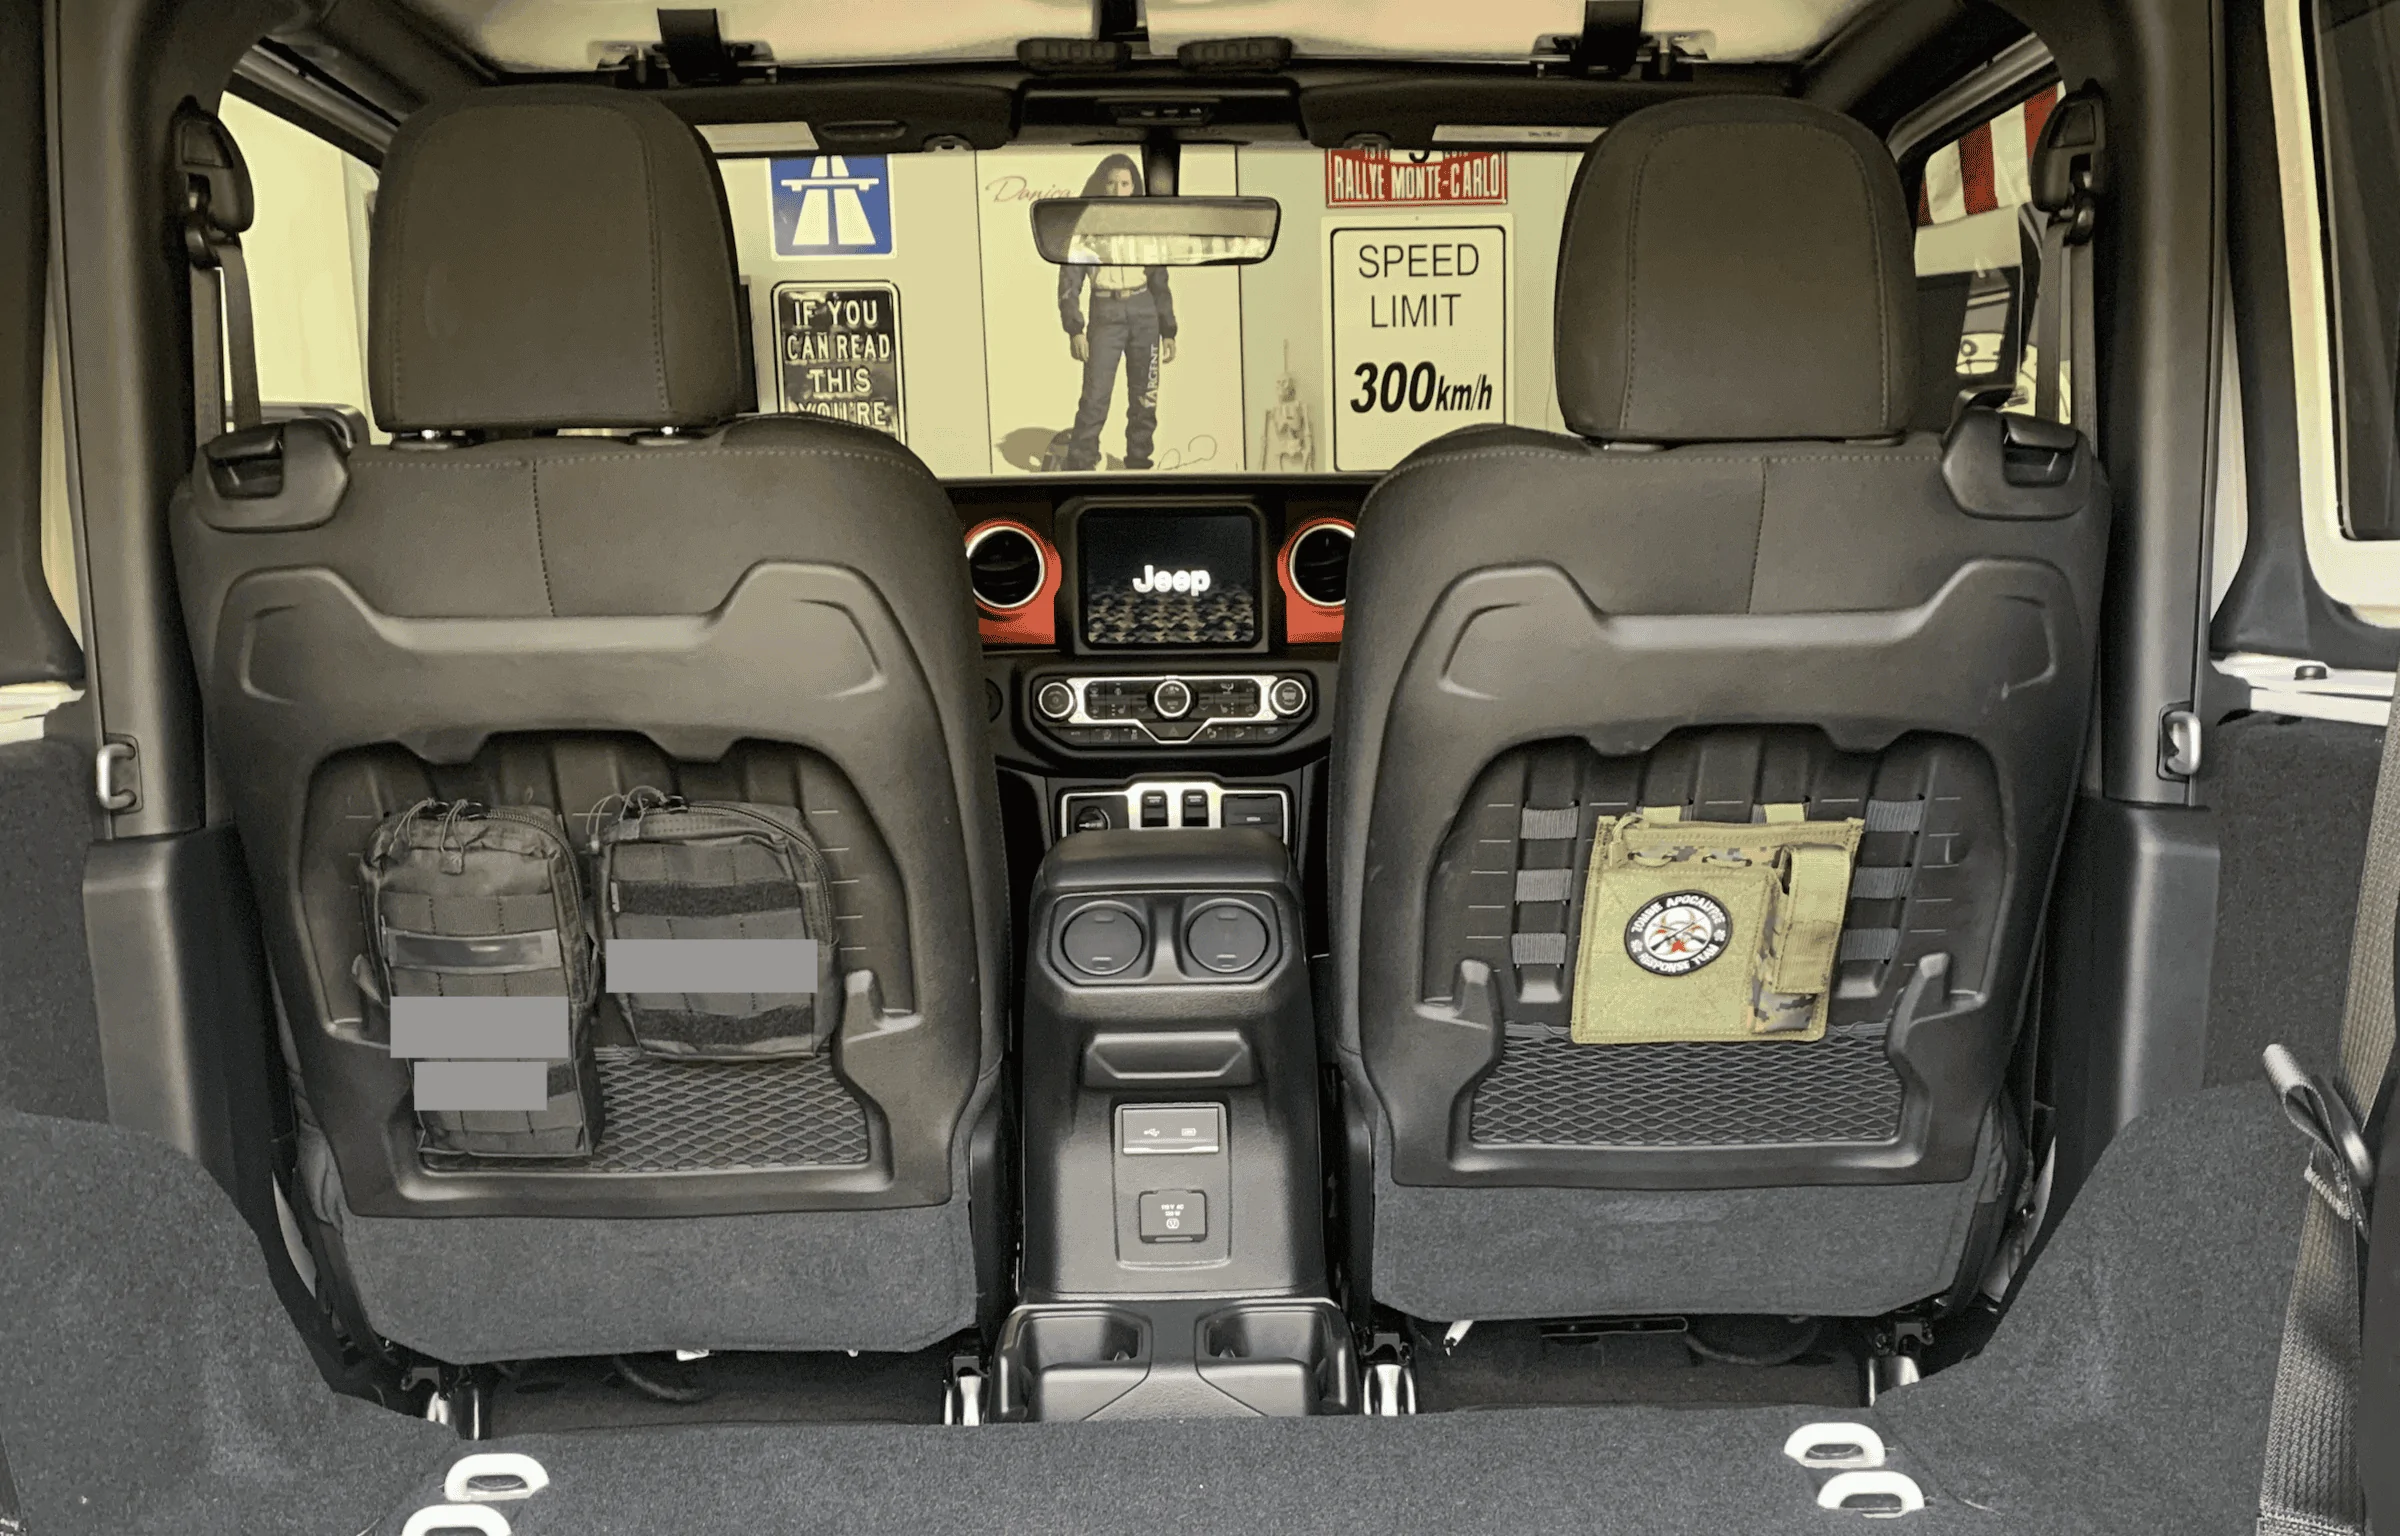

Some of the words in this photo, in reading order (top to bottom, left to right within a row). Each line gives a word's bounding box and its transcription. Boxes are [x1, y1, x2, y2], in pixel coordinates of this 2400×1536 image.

[1334, 154, 1385, 200] RALLYE
[1391, 153, 1500, 199] MONTE-CARLO
[1358, 243, 1480, 279] SPEED
[793, 300, 816, 327] IF
[828, 299, 879, 327] YOU
[1371, 293, 1462, 328] LIMIT
[786, 334, 830, 362] CAN
[837, 333, 891, 361] READ
[810, 367, 872, 393] THIS
[1350, 361, 1493, 414] 300km/h
[1133, 565, 1210, 596] Jeep
[1631, 902, 1663, 932] ZOMBIE
[1666, 895, 1726, 924] APOCALYPSE
[1638, 953, 1690, 973] RESPONSE
[1691, 944, 1719, 965] TEAM
